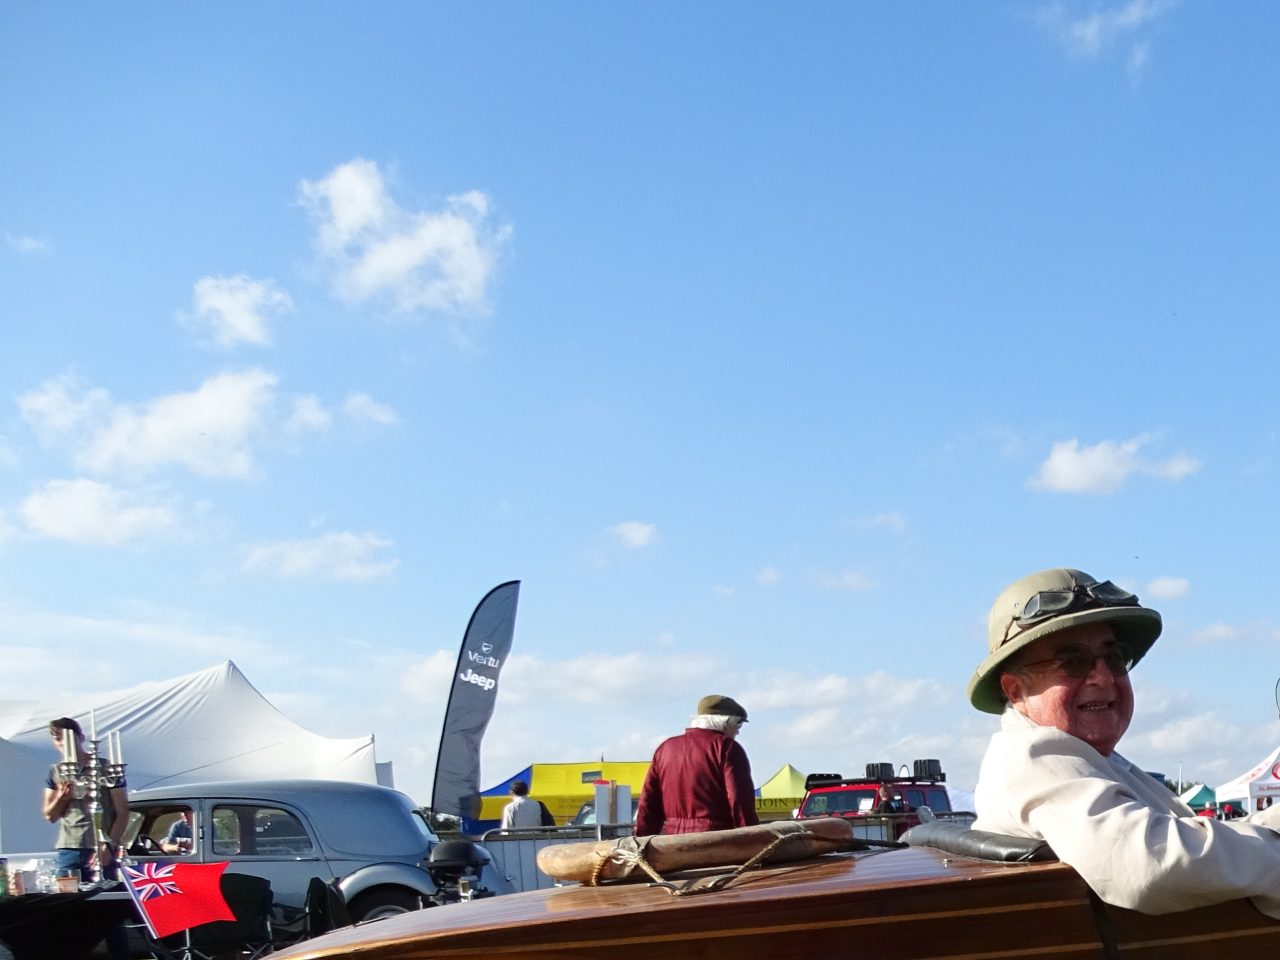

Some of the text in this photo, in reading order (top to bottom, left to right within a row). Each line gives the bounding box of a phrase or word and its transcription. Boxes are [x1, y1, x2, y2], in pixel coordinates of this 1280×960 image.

[468, 650, 499, 668] Vertu
[460, 668, 496, 690] Jeep
[757, 797, 788, 810] JOIN
